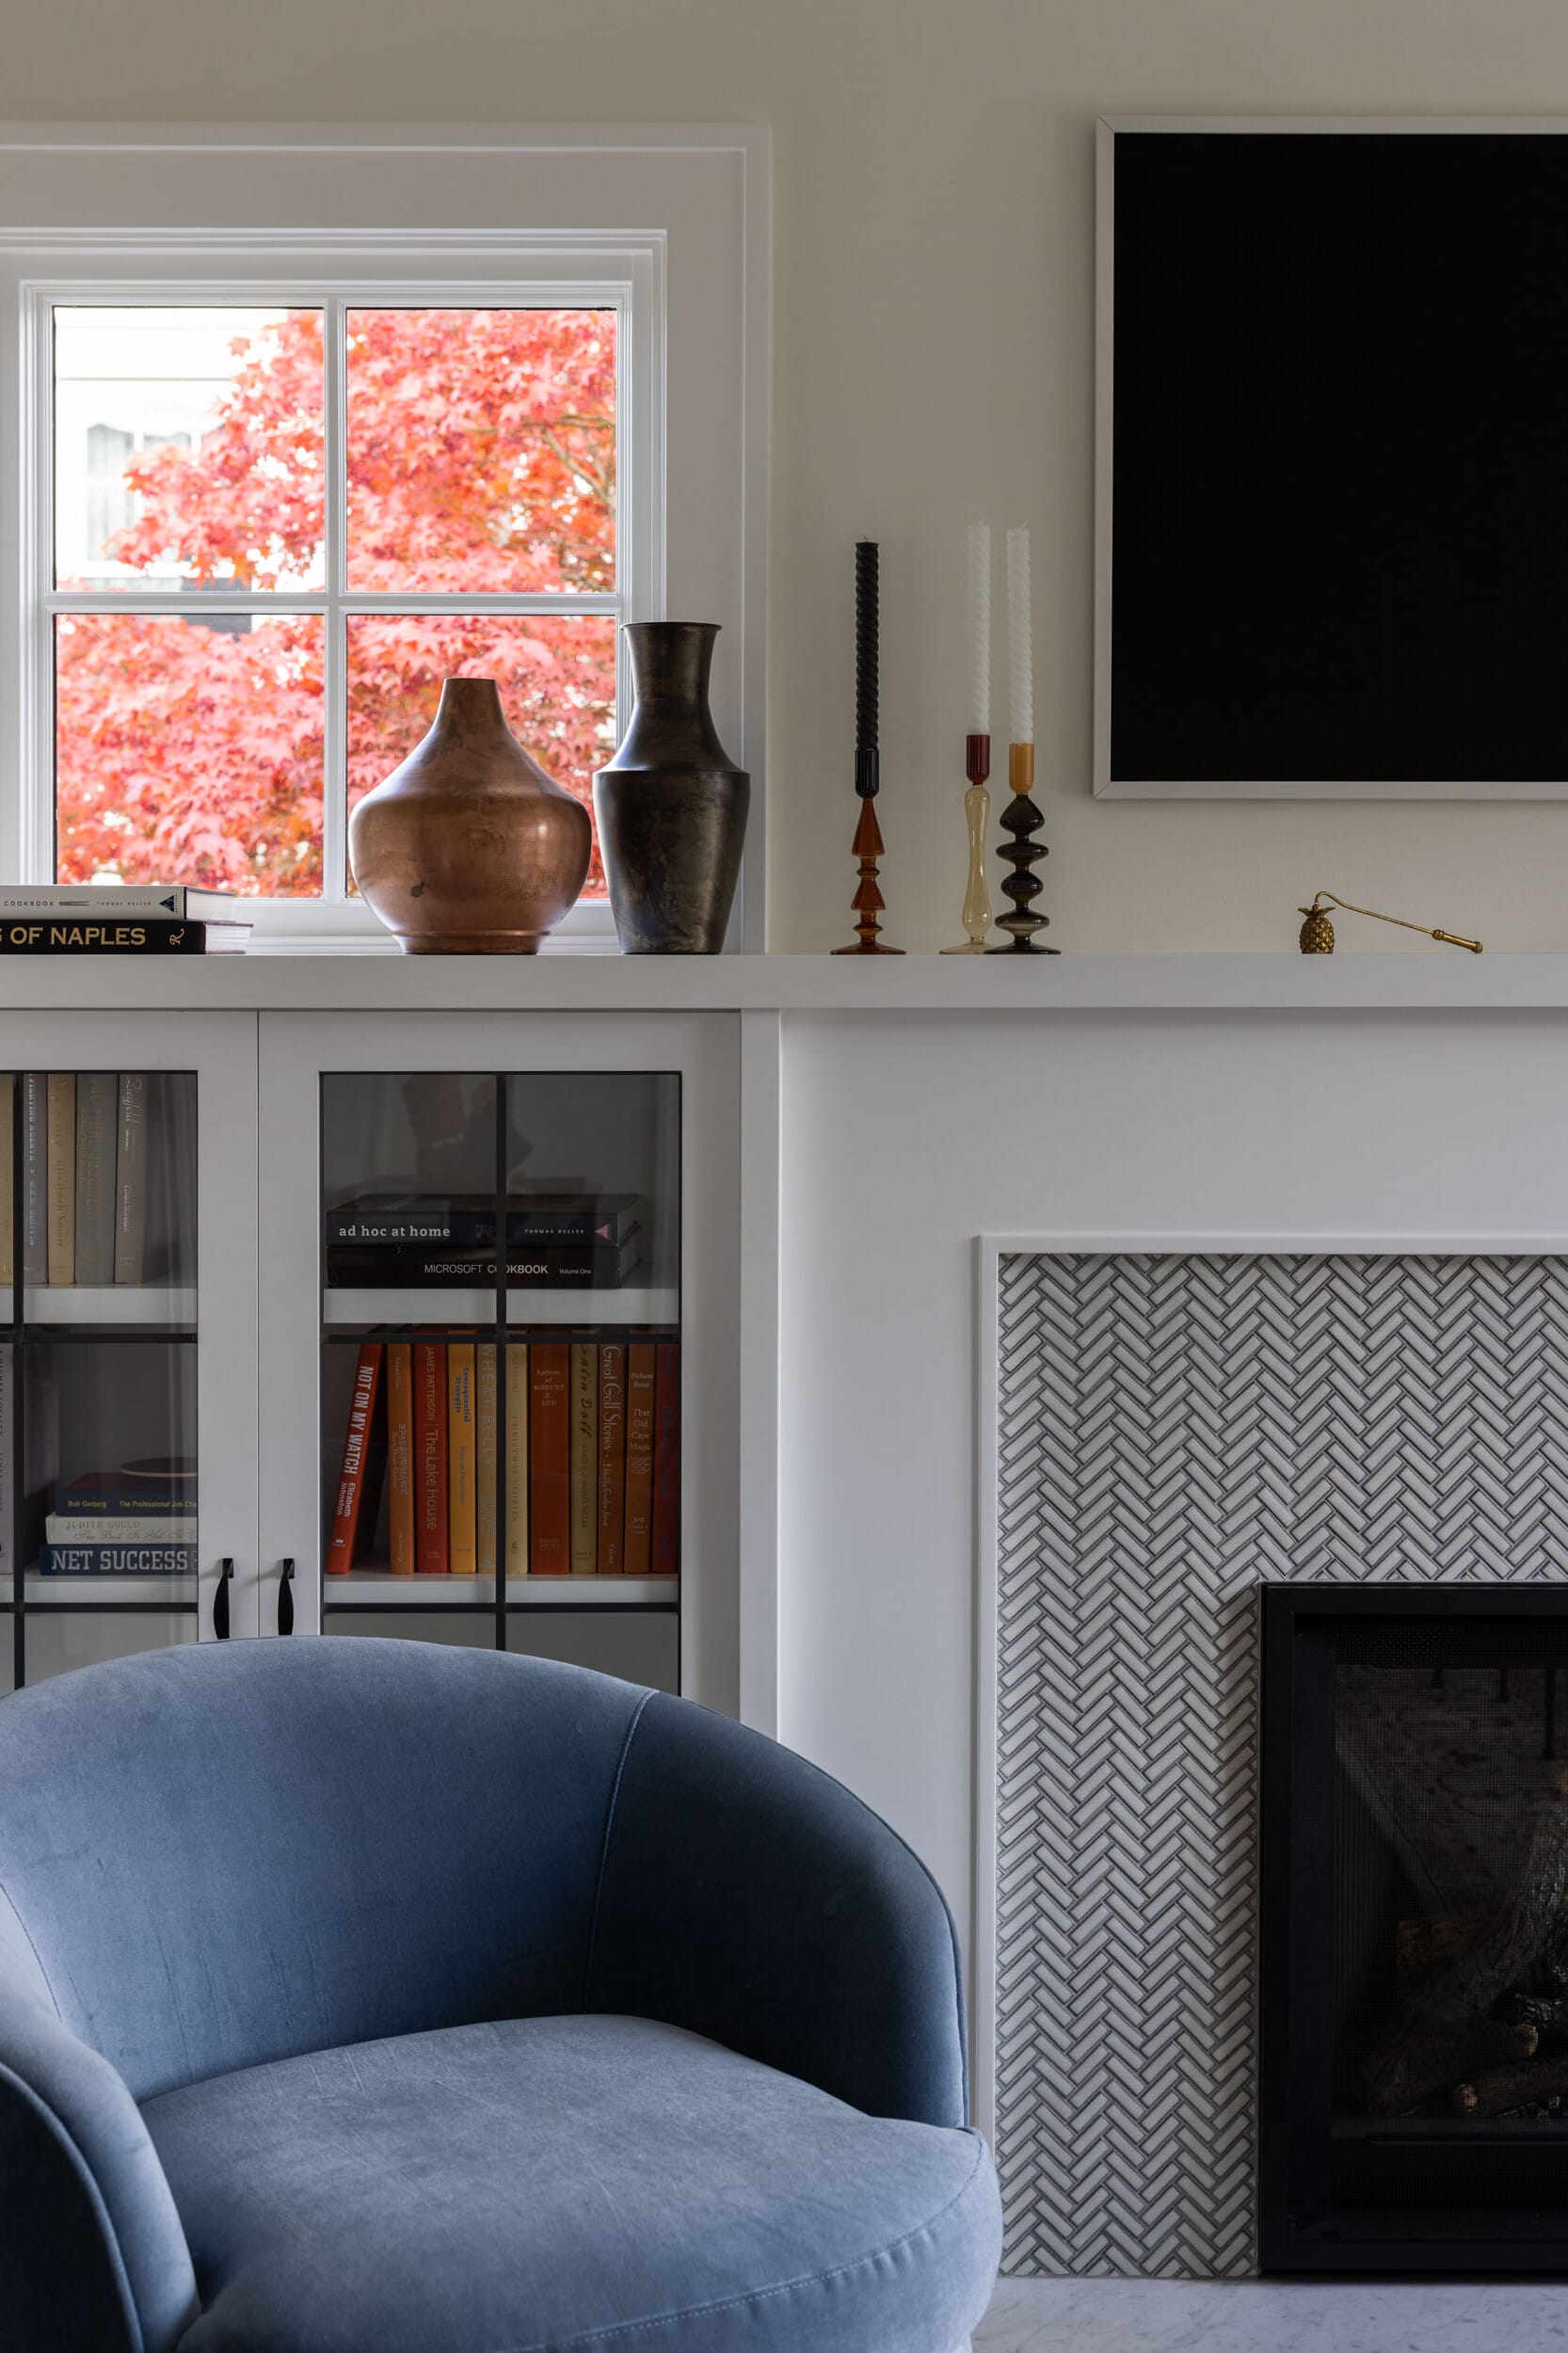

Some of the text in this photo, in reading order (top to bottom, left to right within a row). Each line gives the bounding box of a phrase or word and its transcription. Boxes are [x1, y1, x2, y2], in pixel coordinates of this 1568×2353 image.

[9, 926, 43, 945] OF
[50, 927, 146, 946] NAPLES
[339, 1225, 451, 1237] ad hoc at home
[424, 1264, 483, 1273] MICROSOFT
[487, 1264, 549, 1274] COKBOOK
[481, 1345, 493, 1404] WHEAT
[603, 1346, 622, 1379] Great
[425, 1346, 437, 1421] JAMES PATTERSON
[603, 1383, 622, 1410] Golf
[344, 1366, 375, 1475] NOT ON MY WATCH
[603, 1413, 621, 1450] Stories
[425, 1430, 440, 1529] The Lake House
[337, 1481, 348, 1515] Johnston
[343, 1481, 357, 1517] Elizabeth
[67, 1520, 141, 1529] JUDITH GOULD
[52, 1550, 93, 1570] NET
[100, 1550, 188, 1570] SUCCESS
